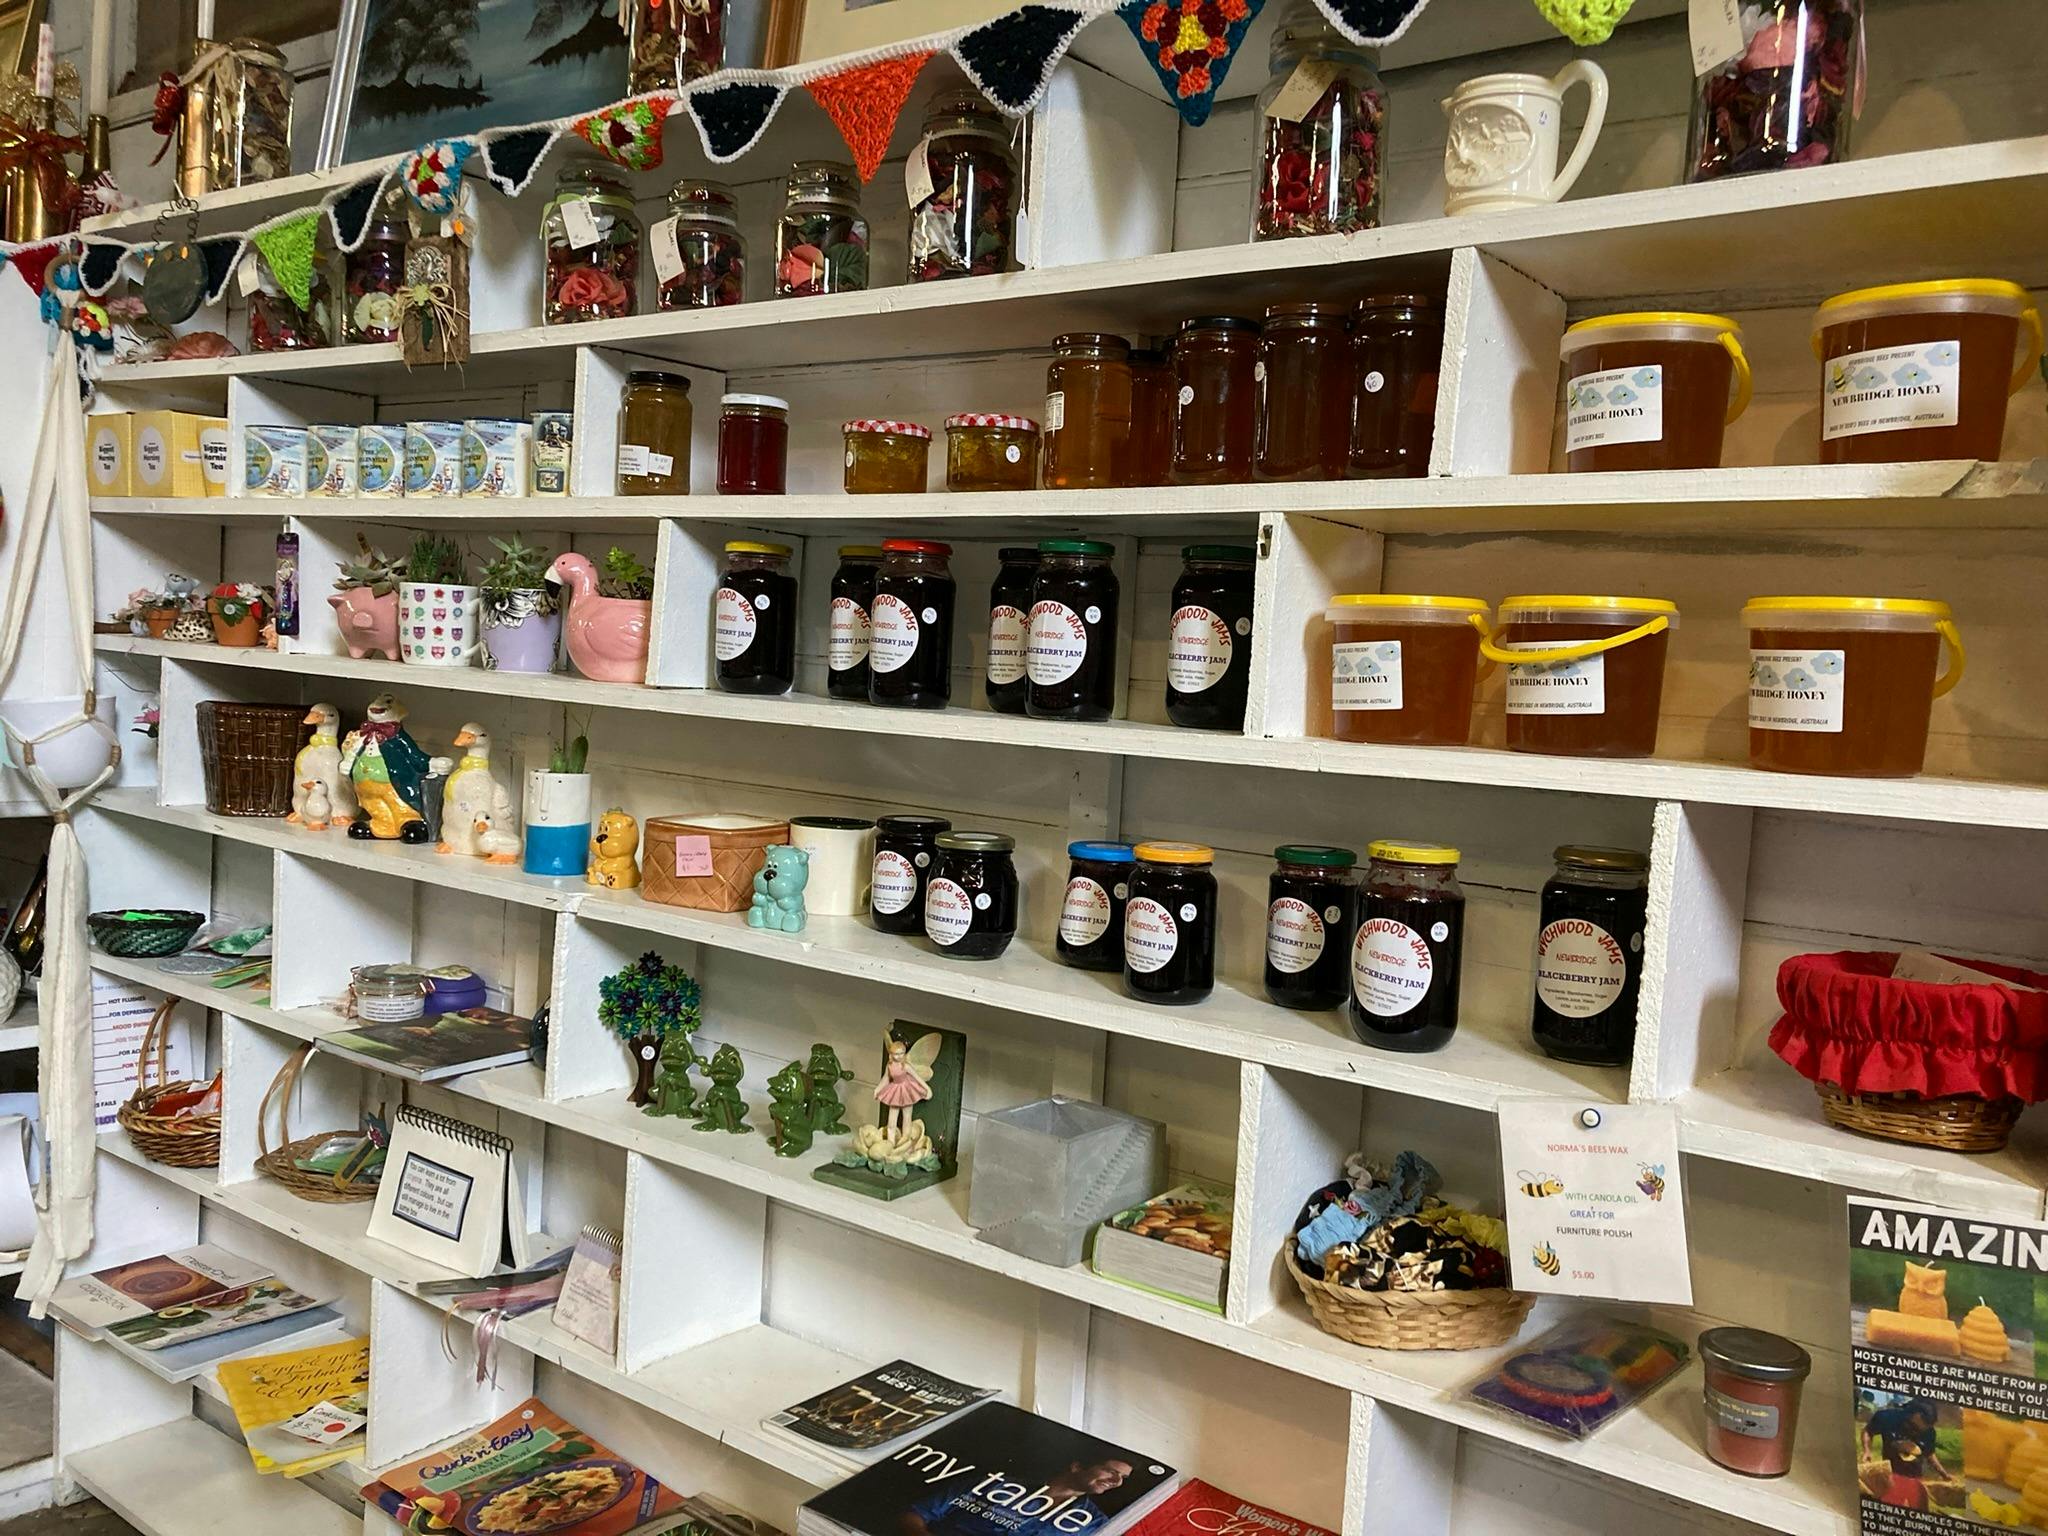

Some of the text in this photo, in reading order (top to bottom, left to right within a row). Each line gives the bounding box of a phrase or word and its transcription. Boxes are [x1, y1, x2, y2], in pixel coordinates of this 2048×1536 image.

[1833, 384, 1943, 407] NEWBRIDGE HONEY
[1608, 407, 1644, 419] HONEY
[1914, 413, 1944, 421] AUSTRALIA
[203, 444, 227, 454] Bigges
[899, 607, 917, 631] JAMS
[1067, 614, 1085, 640] JAMS
[1211, 620, 1230, 646] JAMS
[1065, 650, 1082, 658] JAM
[1209, 656, 1226, 664] JAM
[1359, 675, 1389, 684] HONEY
[1553, 677, 1589, 686] HONEY
[1787, 691, 1826, 700] HONEY
[900, 860, 915, 877] JAMS
[955, 891, 970, 911] JAMS
[1094, 889, 1108, 909] JAMS
[954, 918, 969, 926] JAM
[1092, 917, 1107, 925] JAM
[1158, 913, 1175, 935] JAMS
[1307, 912, 1322, 933] JAMS
[1158, 942, 1174, 951] JAM
[1305, 942, 1321, 950] JAM
[1410, 939, 1430, 969] JAMS
[1597, 934, 1623, 965] JAMS
[1369, 950, 1407, 966] NEWBRIDGE
[1556, 953, 1598, 965] NEWBRIDGE
[1355, 962, 1425, 989] BLACKBERRY JAM
[1538, 969, 1620, 986] BLACKBERRY JAM
[1547, 1144, 1629, 1155] NORMA'S BEES WAX
[1565, 1192, 1638, 1204] WITH CANOLA OIL
[1570, 1209, 1615, 1220] GREAT FOR
[1556, 1226, 1633, 1239] FURNITURE POLISH
[1861, 1209, 2048, 1272] AMAZIN
[1572, 1271, 1595, 1280] $5.00
[1854, 1350, 2036, 1392] MOST CANDLES ARE MADE FROM
[876, 1373, 917, 1392] BEST
[1854, 1362, 2043, 1406] PETROLEUM REFINING. WHEN YOU
[1855, 1374, 2048, 1420] THE SAME TOXINS AS DIESEL FUEL
[489, 1423, 534, 1451] Easy
[893, 1443, 976, 1484] my
[971, 1471, 1093, 1533] table
[950, 1496, 982, 1514] pete
[982, 1511, 1024, 1531] evans
[1235, 1503, 1301, 1536] Women's
[1861, 1499, 1906, 1517] BEESWAX
[1909, 1510, 1953, 1528] CANDLES
[1955, 1520, 1971, 1531] ON
[1862, 1510, 1934, 1534] AS THEY BURN.
[1863, 1521, 1876, 1530] TO
